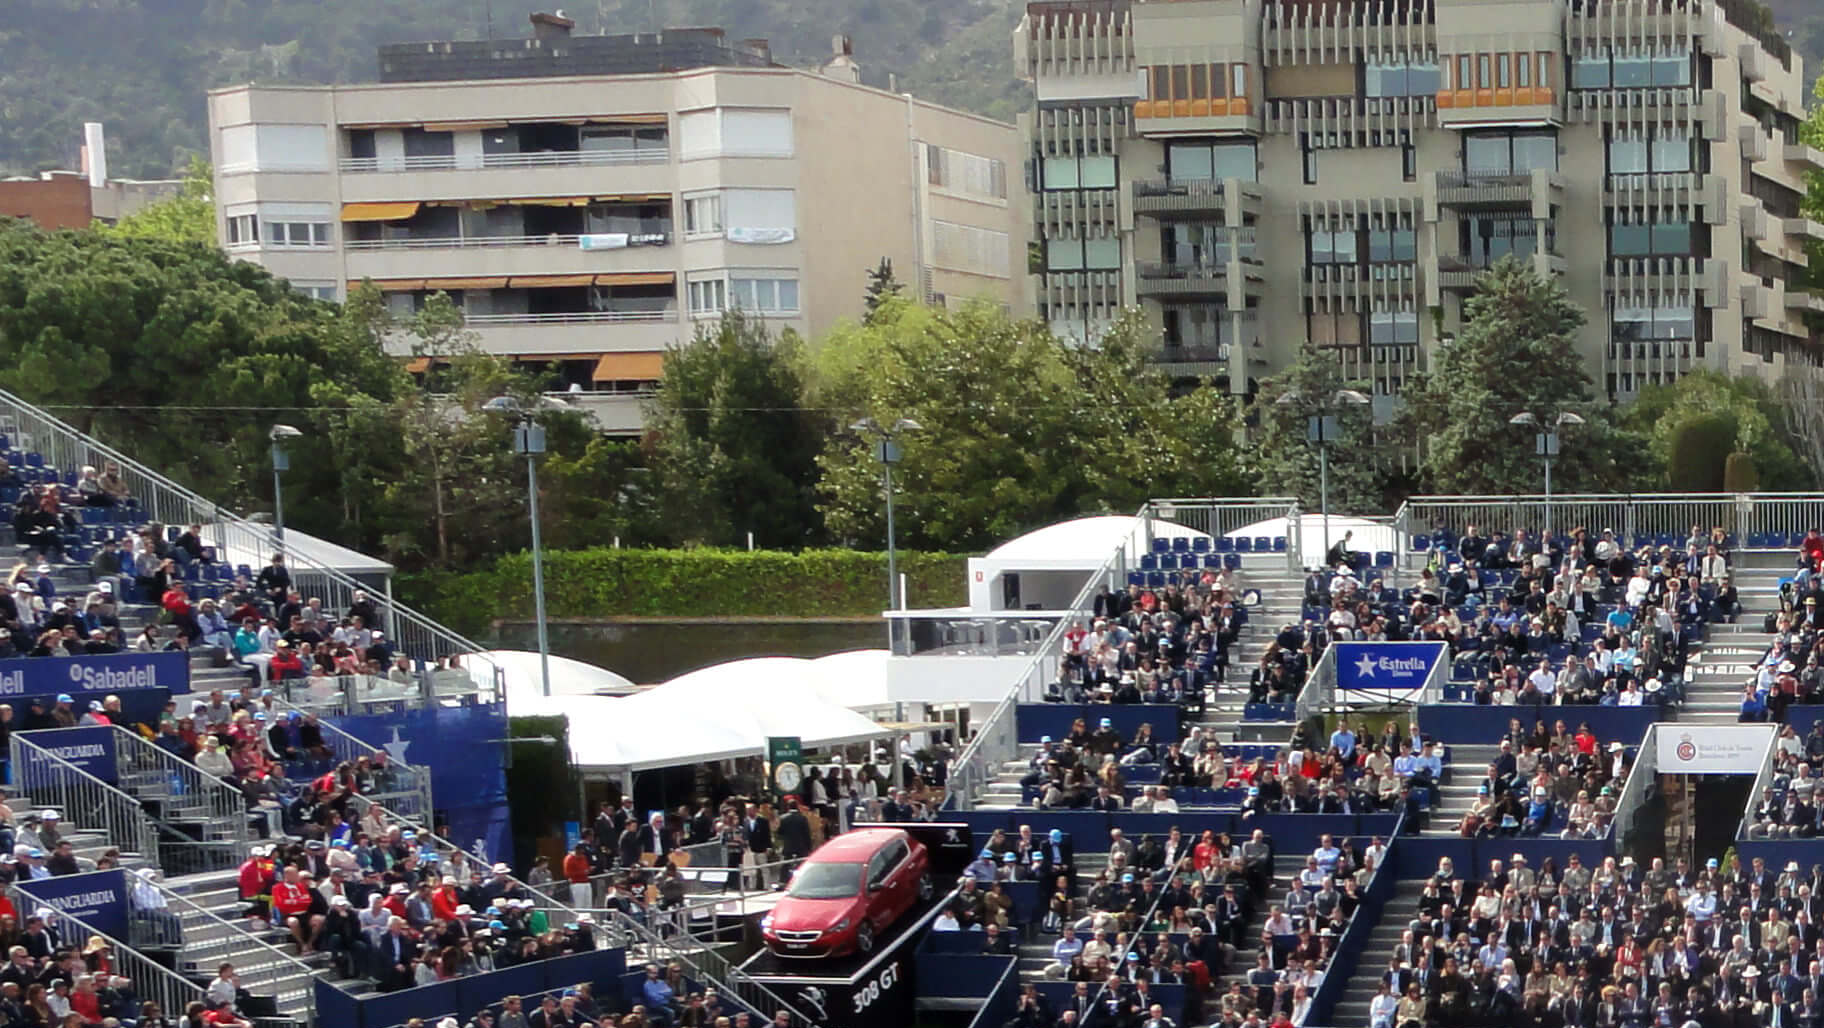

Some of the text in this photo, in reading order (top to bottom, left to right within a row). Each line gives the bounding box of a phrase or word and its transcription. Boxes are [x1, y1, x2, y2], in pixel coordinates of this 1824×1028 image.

[1378, 656, 1426, 671] Estrella
[83, 664, 156, 690] Sabadell
[853, 962, 899, 1013] 308 GT
